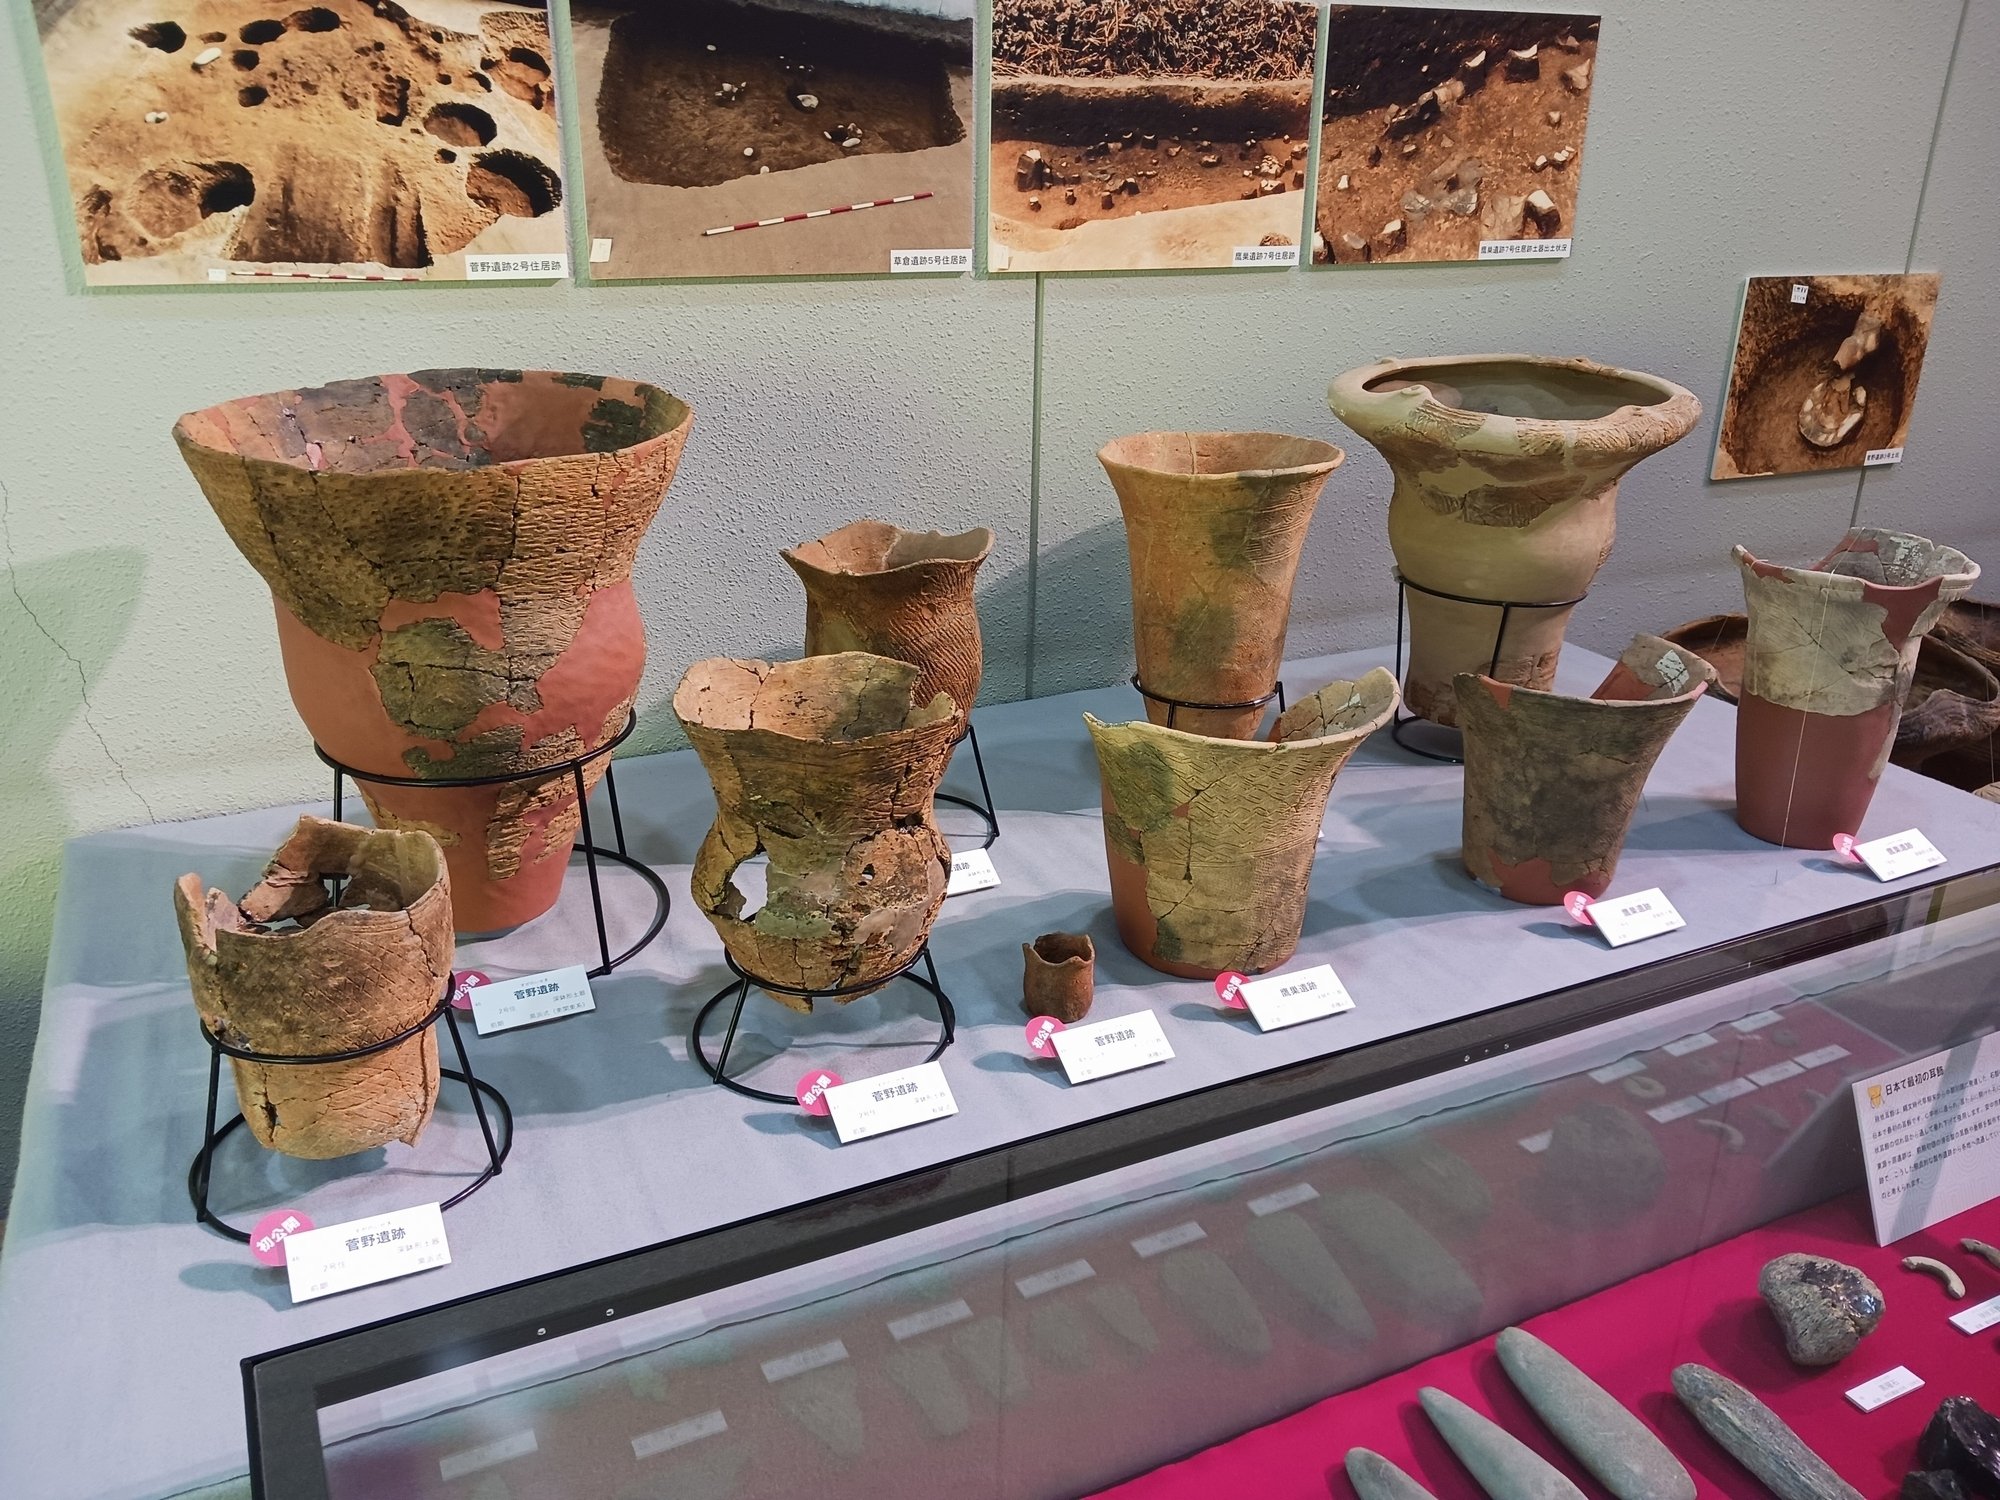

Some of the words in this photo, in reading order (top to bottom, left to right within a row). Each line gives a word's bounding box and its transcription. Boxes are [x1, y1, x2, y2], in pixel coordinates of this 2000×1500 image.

[469, 260, 562, 273] 菅野遺跡2号住居跡
[893, 255, 968, 266] 草倉遺跡5号住居跡
[513, 982, 560, 1000] 菅野遺跡
[1093, 1028, 1136, 1047] 菅野遺跡
[871, 1081, 919, 1103] 菅野遺跡
[256, 1215, 301, 1253] 初公開
[344, 1226, 407, 1252] 菅野遺跡
